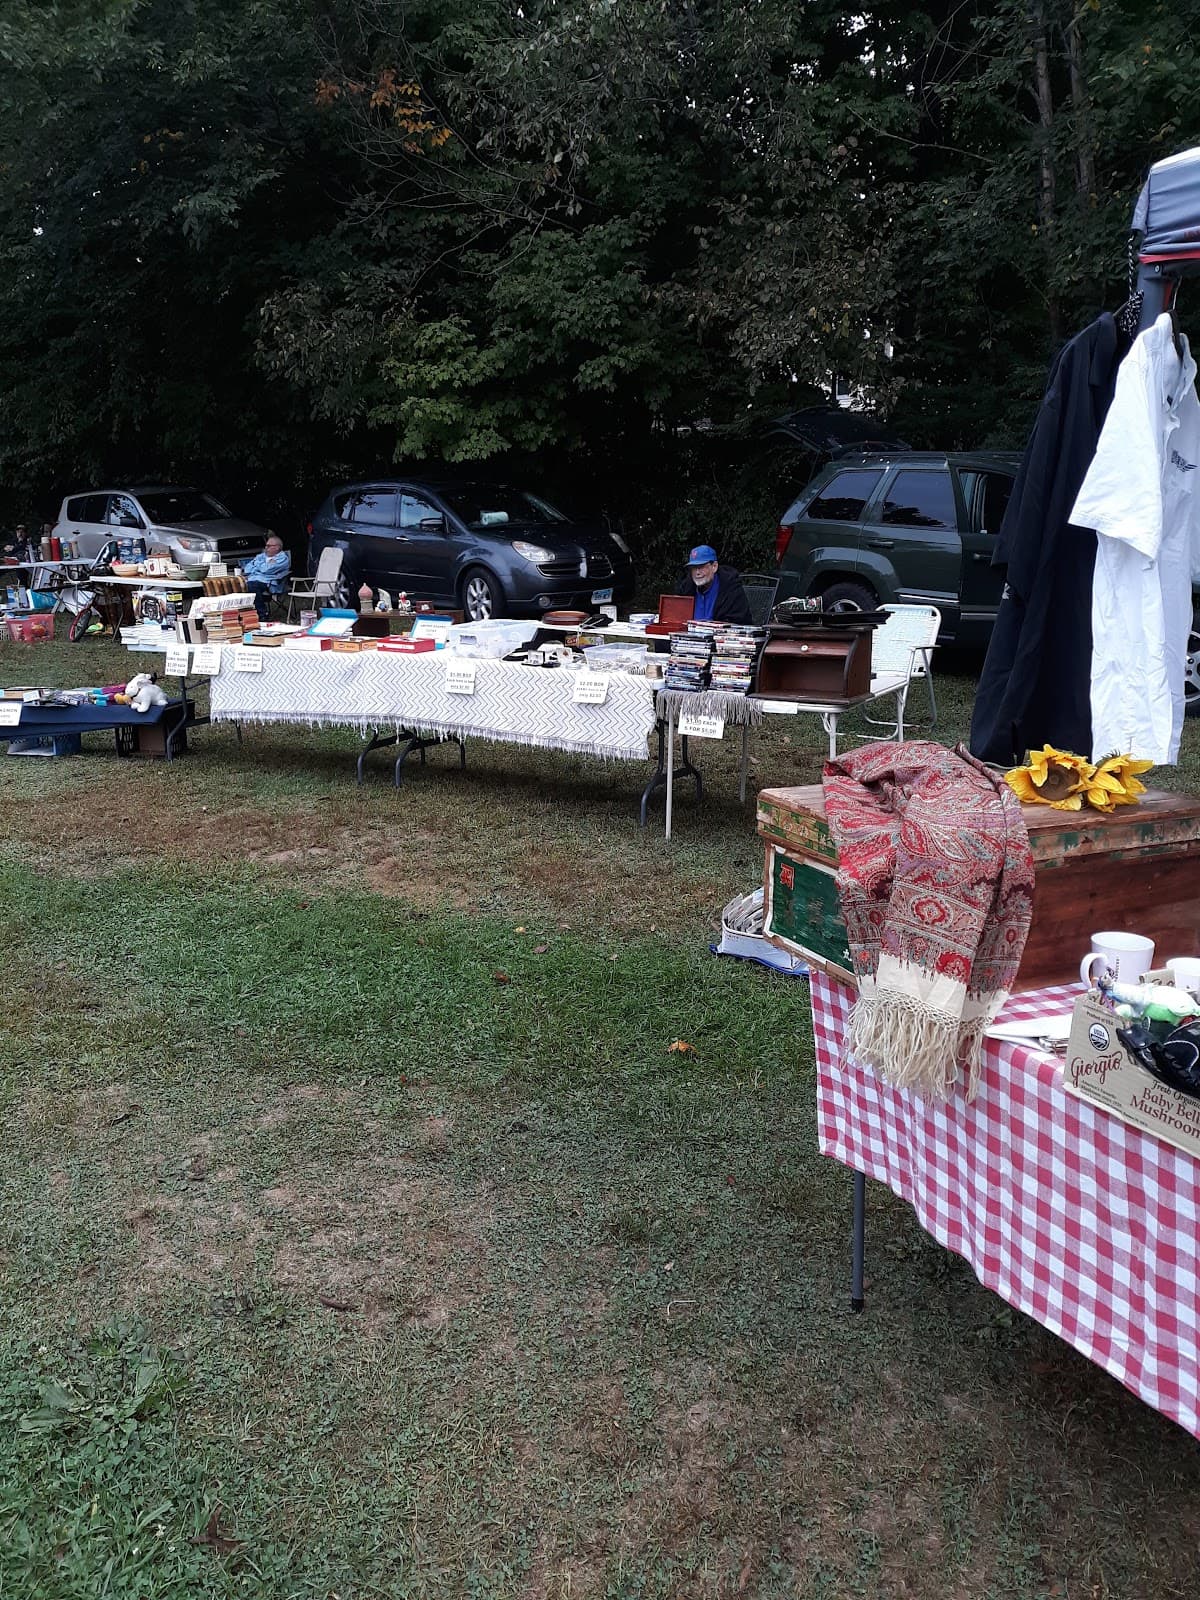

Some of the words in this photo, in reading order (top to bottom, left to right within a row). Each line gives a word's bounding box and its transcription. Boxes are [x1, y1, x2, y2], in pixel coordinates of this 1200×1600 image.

[1071, 1051, 1122, 1088] Giorgio
[1151, 1079, 1171, 1095] Fresh
[1143, 1088, 1174, 1113] Baby
[1176, 1103, 1200, 1124] Bell
